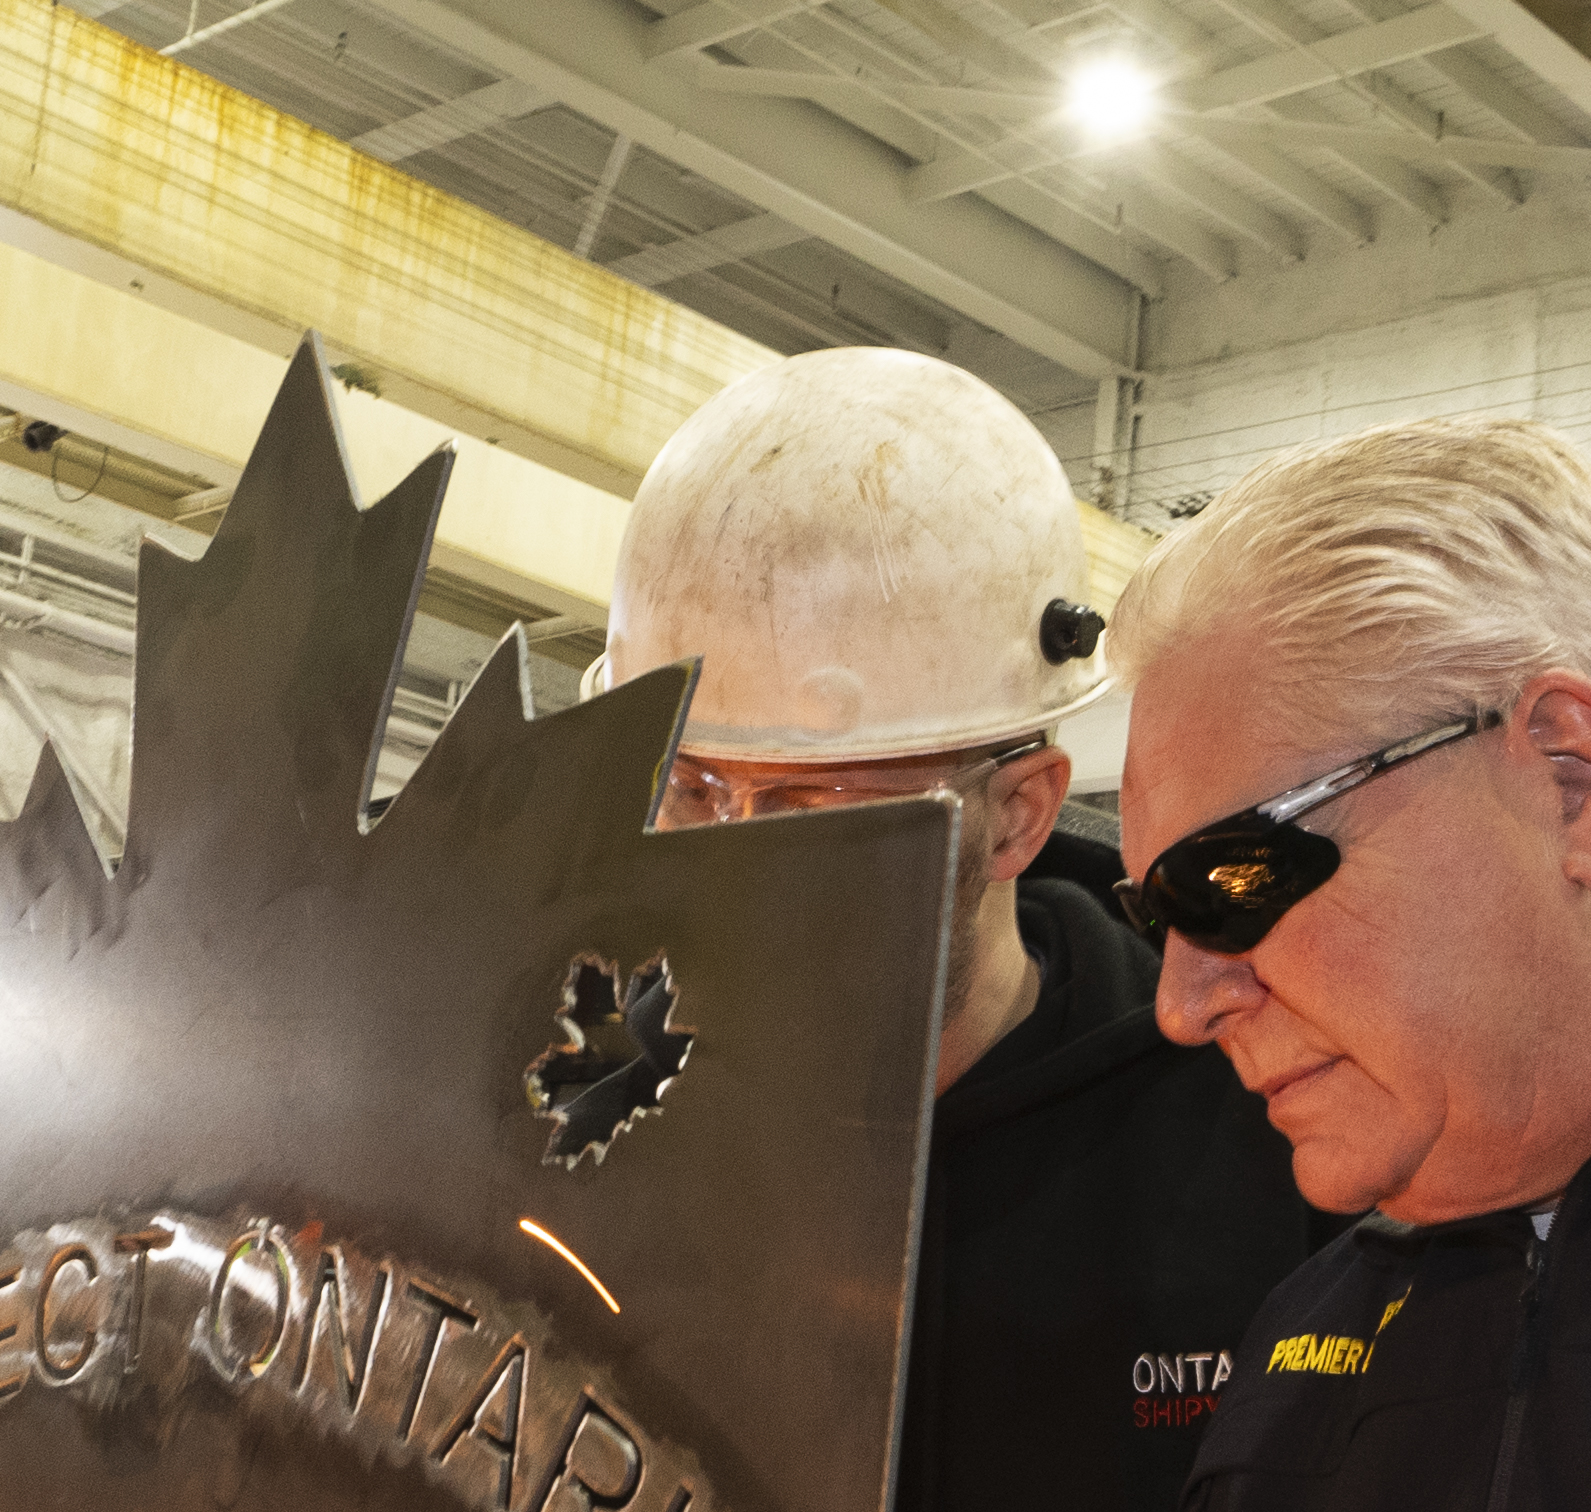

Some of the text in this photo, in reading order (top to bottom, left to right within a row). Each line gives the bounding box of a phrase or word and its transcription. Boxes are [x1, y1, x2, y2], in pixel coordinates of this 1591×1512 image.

[1132, 1349, 1234, 1393] ONTA
[1265, 1333, 1365, 1375] PREMIER
[1132, 1395, 1221, 1428] SHIPY
